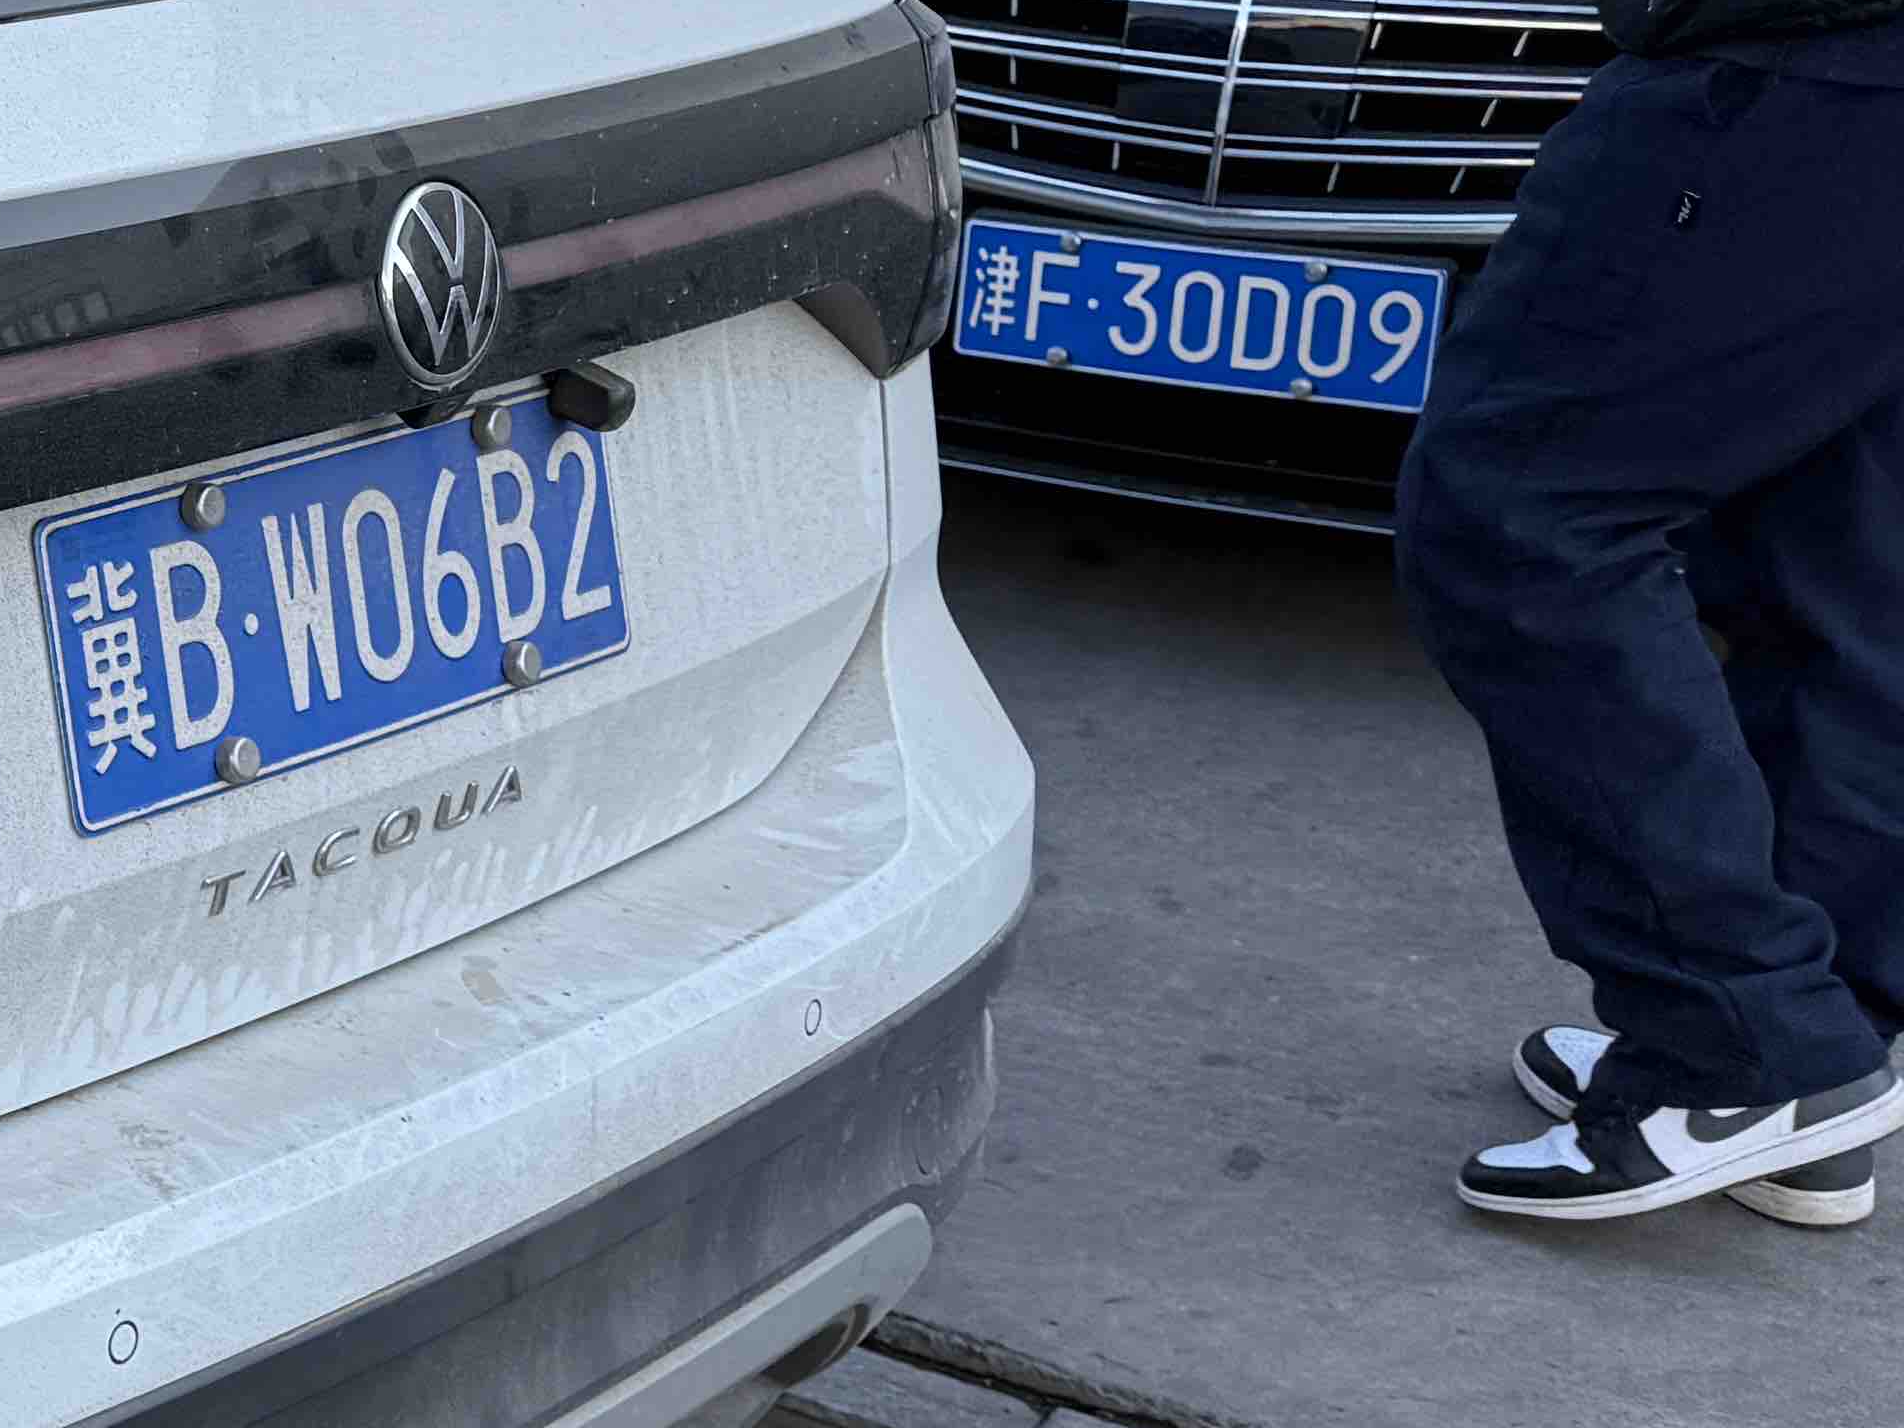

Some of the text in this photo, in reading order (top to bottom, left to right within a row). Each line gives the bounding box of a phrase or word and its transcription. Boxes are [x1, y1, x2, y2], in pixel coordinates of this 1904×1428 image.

[969, 245, 1425, 384] 津F·30D09
[66, 430, 613, 775] 冀B·W06B2
[200, 765, 524, 918] TACQUA
